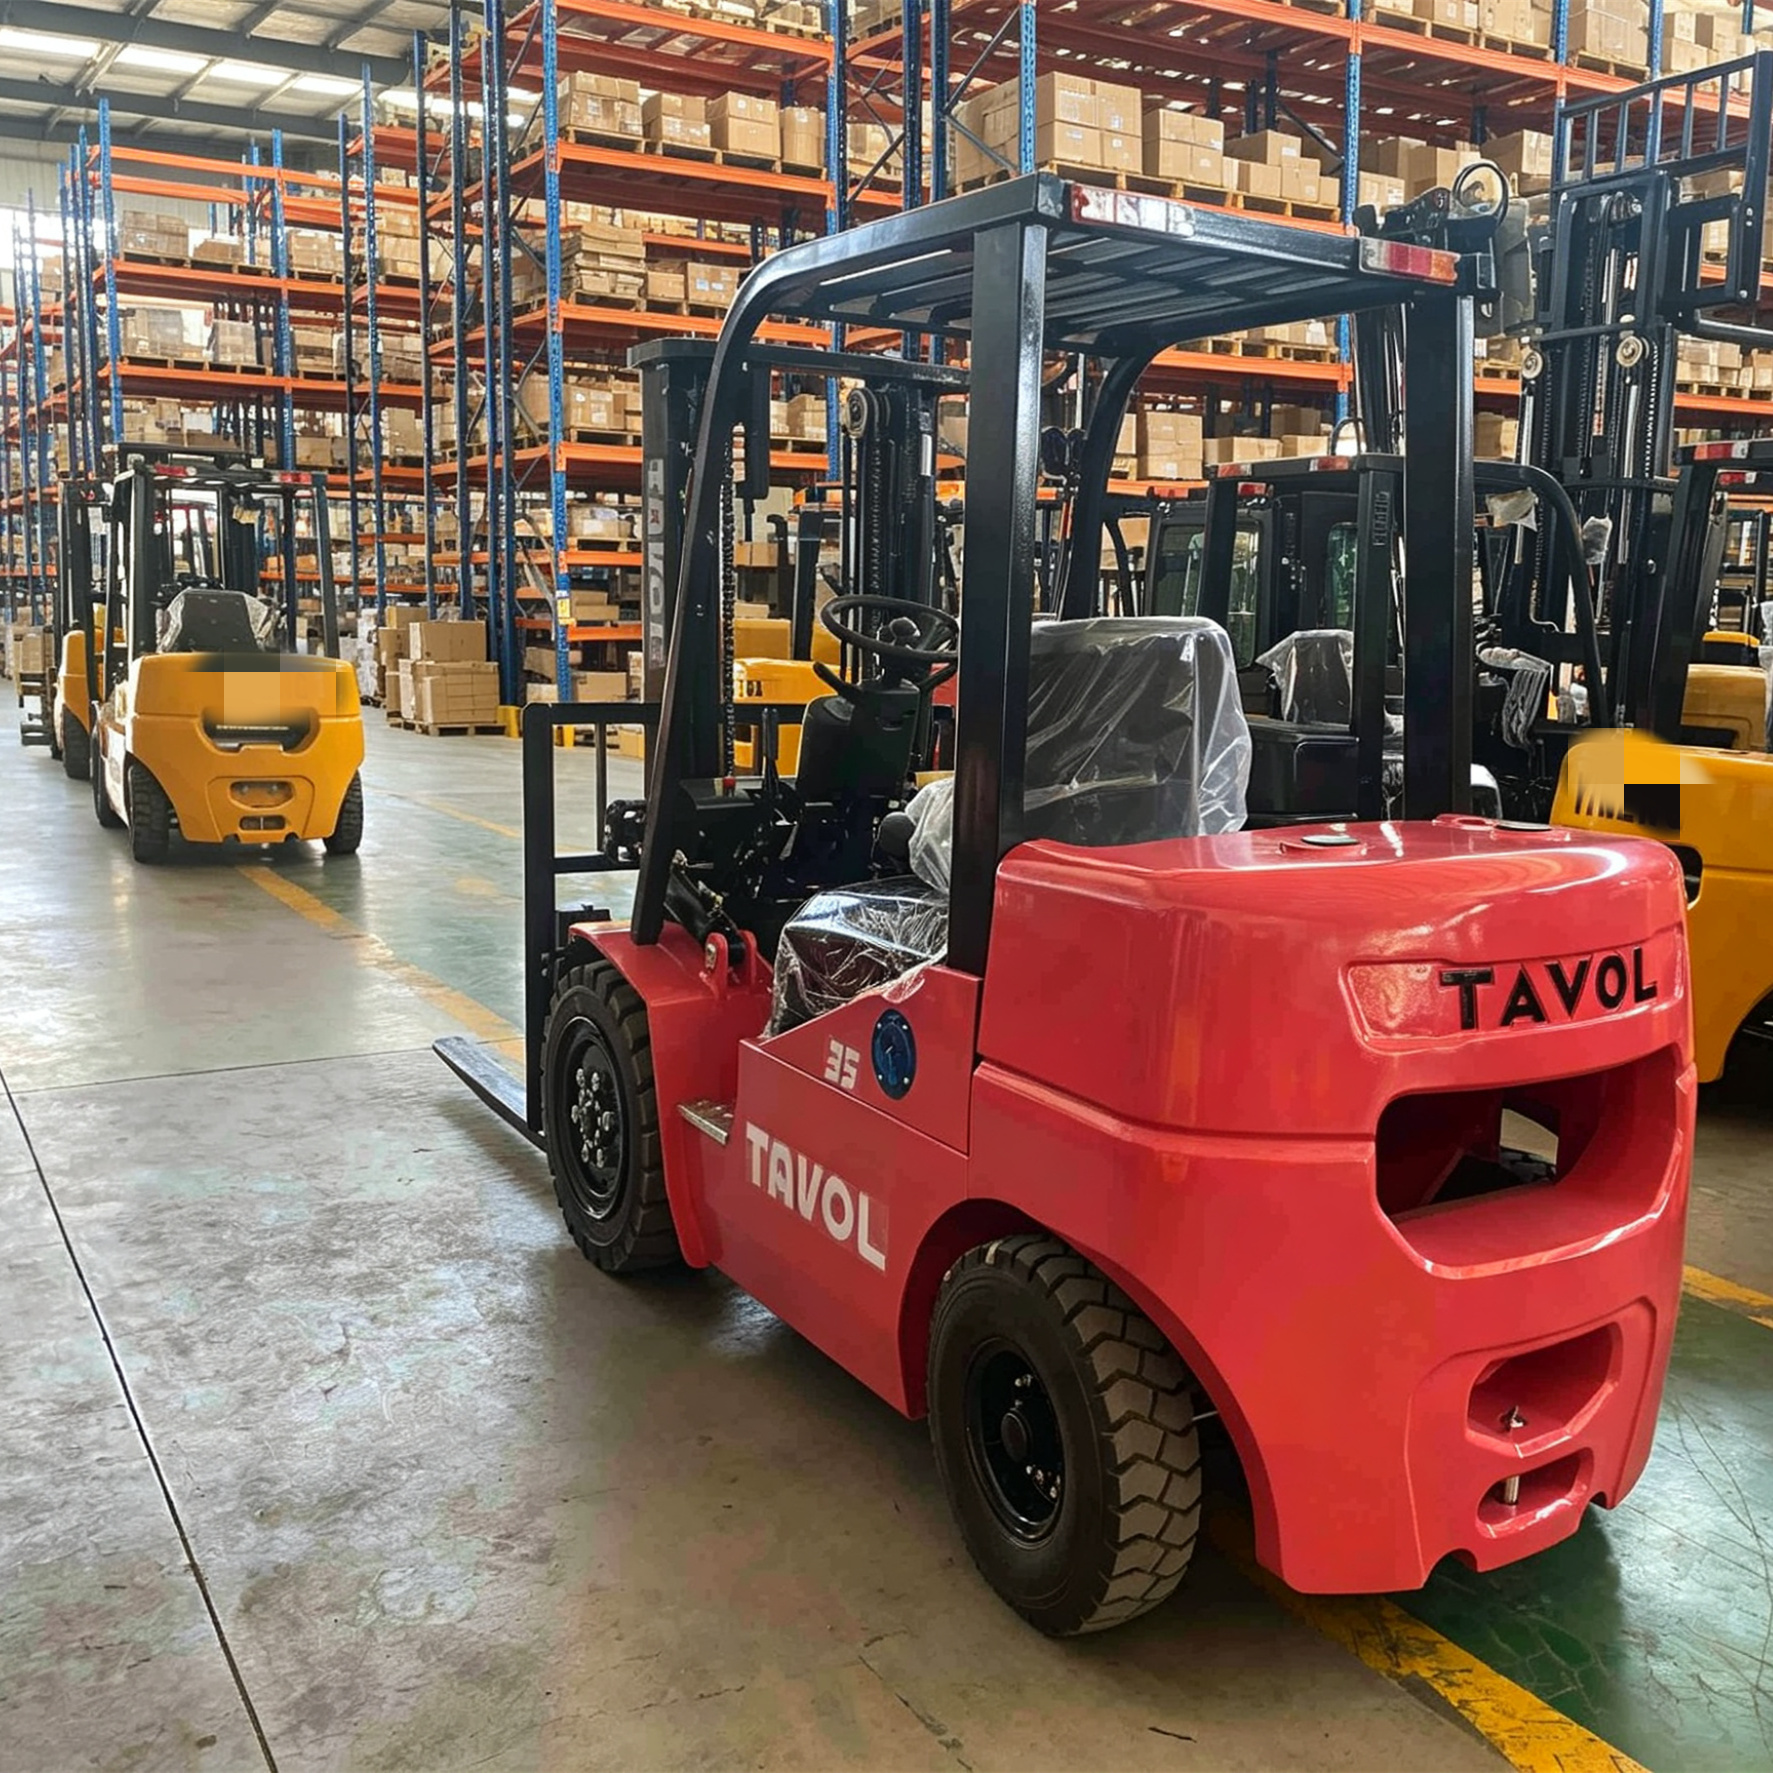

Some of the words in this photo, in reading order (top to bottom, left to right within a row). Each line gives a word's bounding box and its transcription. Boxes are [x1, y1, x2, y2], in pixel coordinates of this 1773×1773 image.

[1440, 947, 1657, 1030] TAVOL
[824, 1039, 860, 1090] 35
[746, 1121, 886, 1271] TAVOL
